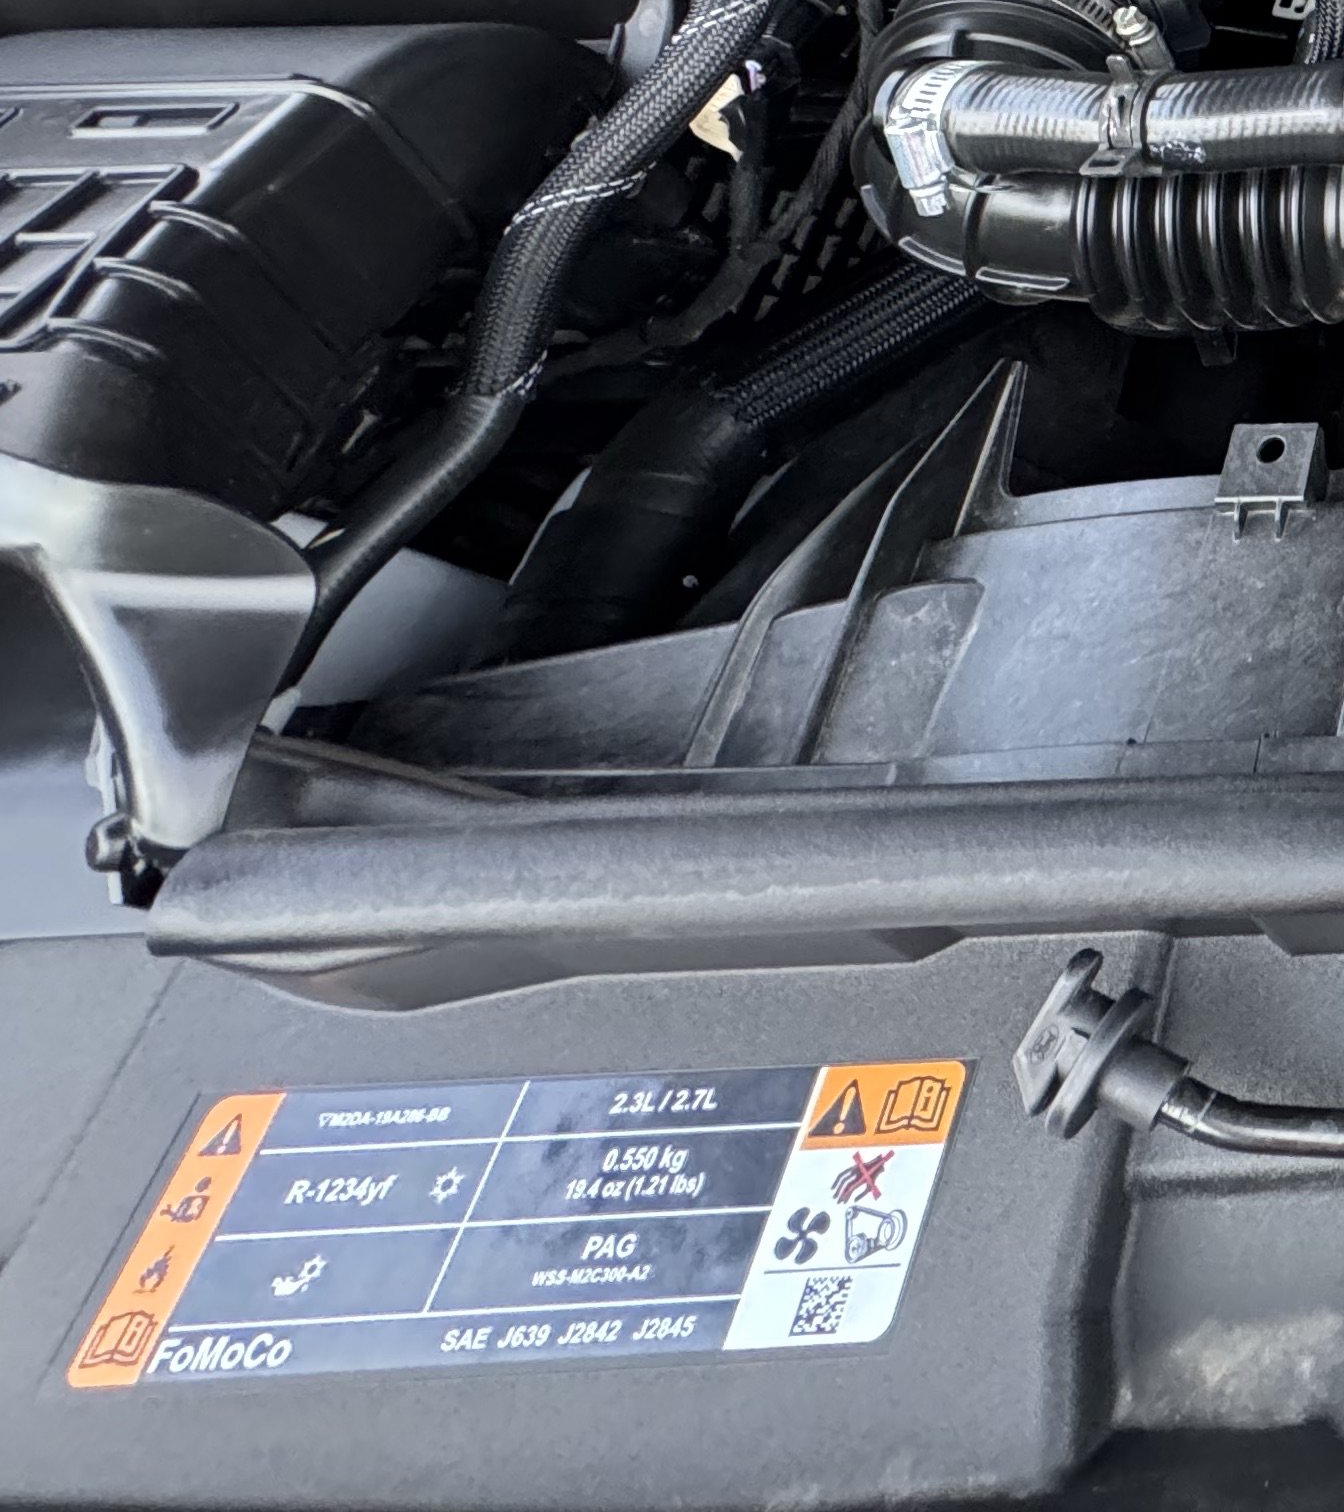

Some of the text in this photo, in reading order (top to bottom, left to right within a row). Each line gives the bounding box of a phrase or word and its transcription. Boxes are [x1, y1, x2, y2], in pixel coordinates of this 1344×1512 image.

[609, 1091, 656, 1115] 2.3L
[671, 1087, 719, 1112] 2.7L
[602, 1145, 690, 1174] 0.550 kg
[283, 1174, 400, 1207] R-1234yf
[565, 1172, 706, 1202] 19.4 oz (1.21 lbs)
[580, 1232, 640, 1261] PAG
[440, 1315, 698, 1353] SAE J639 J2842 J2845
[146, 1332, 293, 1374] FoMoCo
